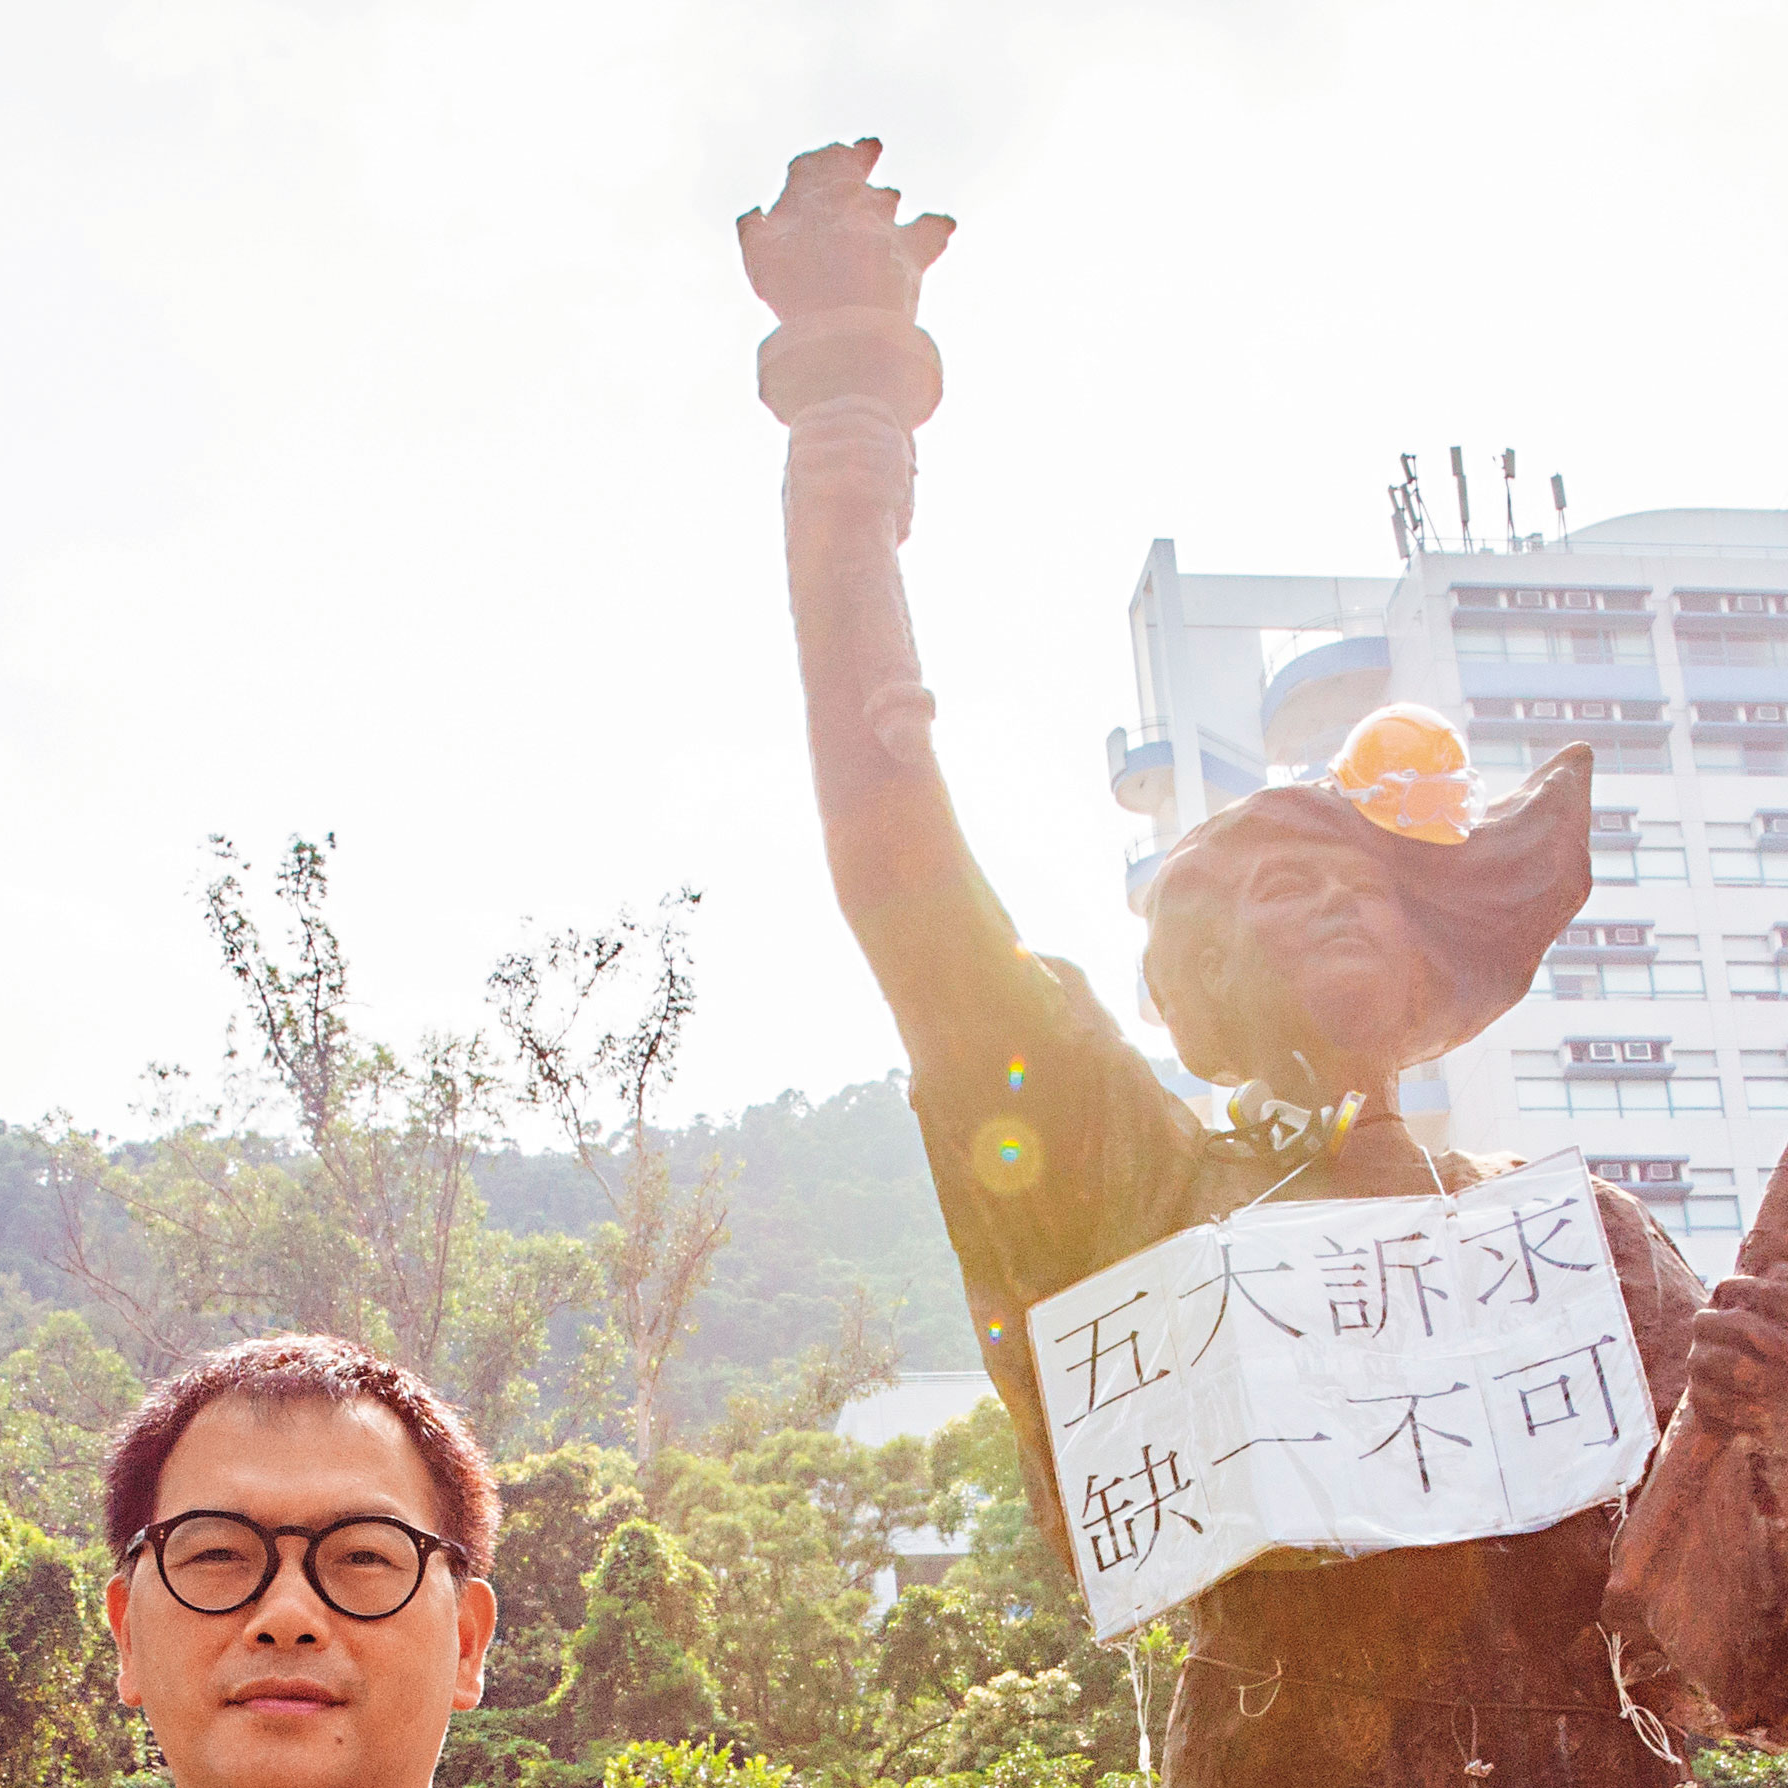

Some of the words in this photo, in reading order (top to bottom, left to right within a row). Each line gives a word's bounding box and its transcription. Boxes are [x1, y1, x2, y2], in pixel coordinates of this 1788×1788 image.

[1054, 1198, 1597, 1428] 五大訴求
[1081, 1334, 1617, 1573] 缺一不可
